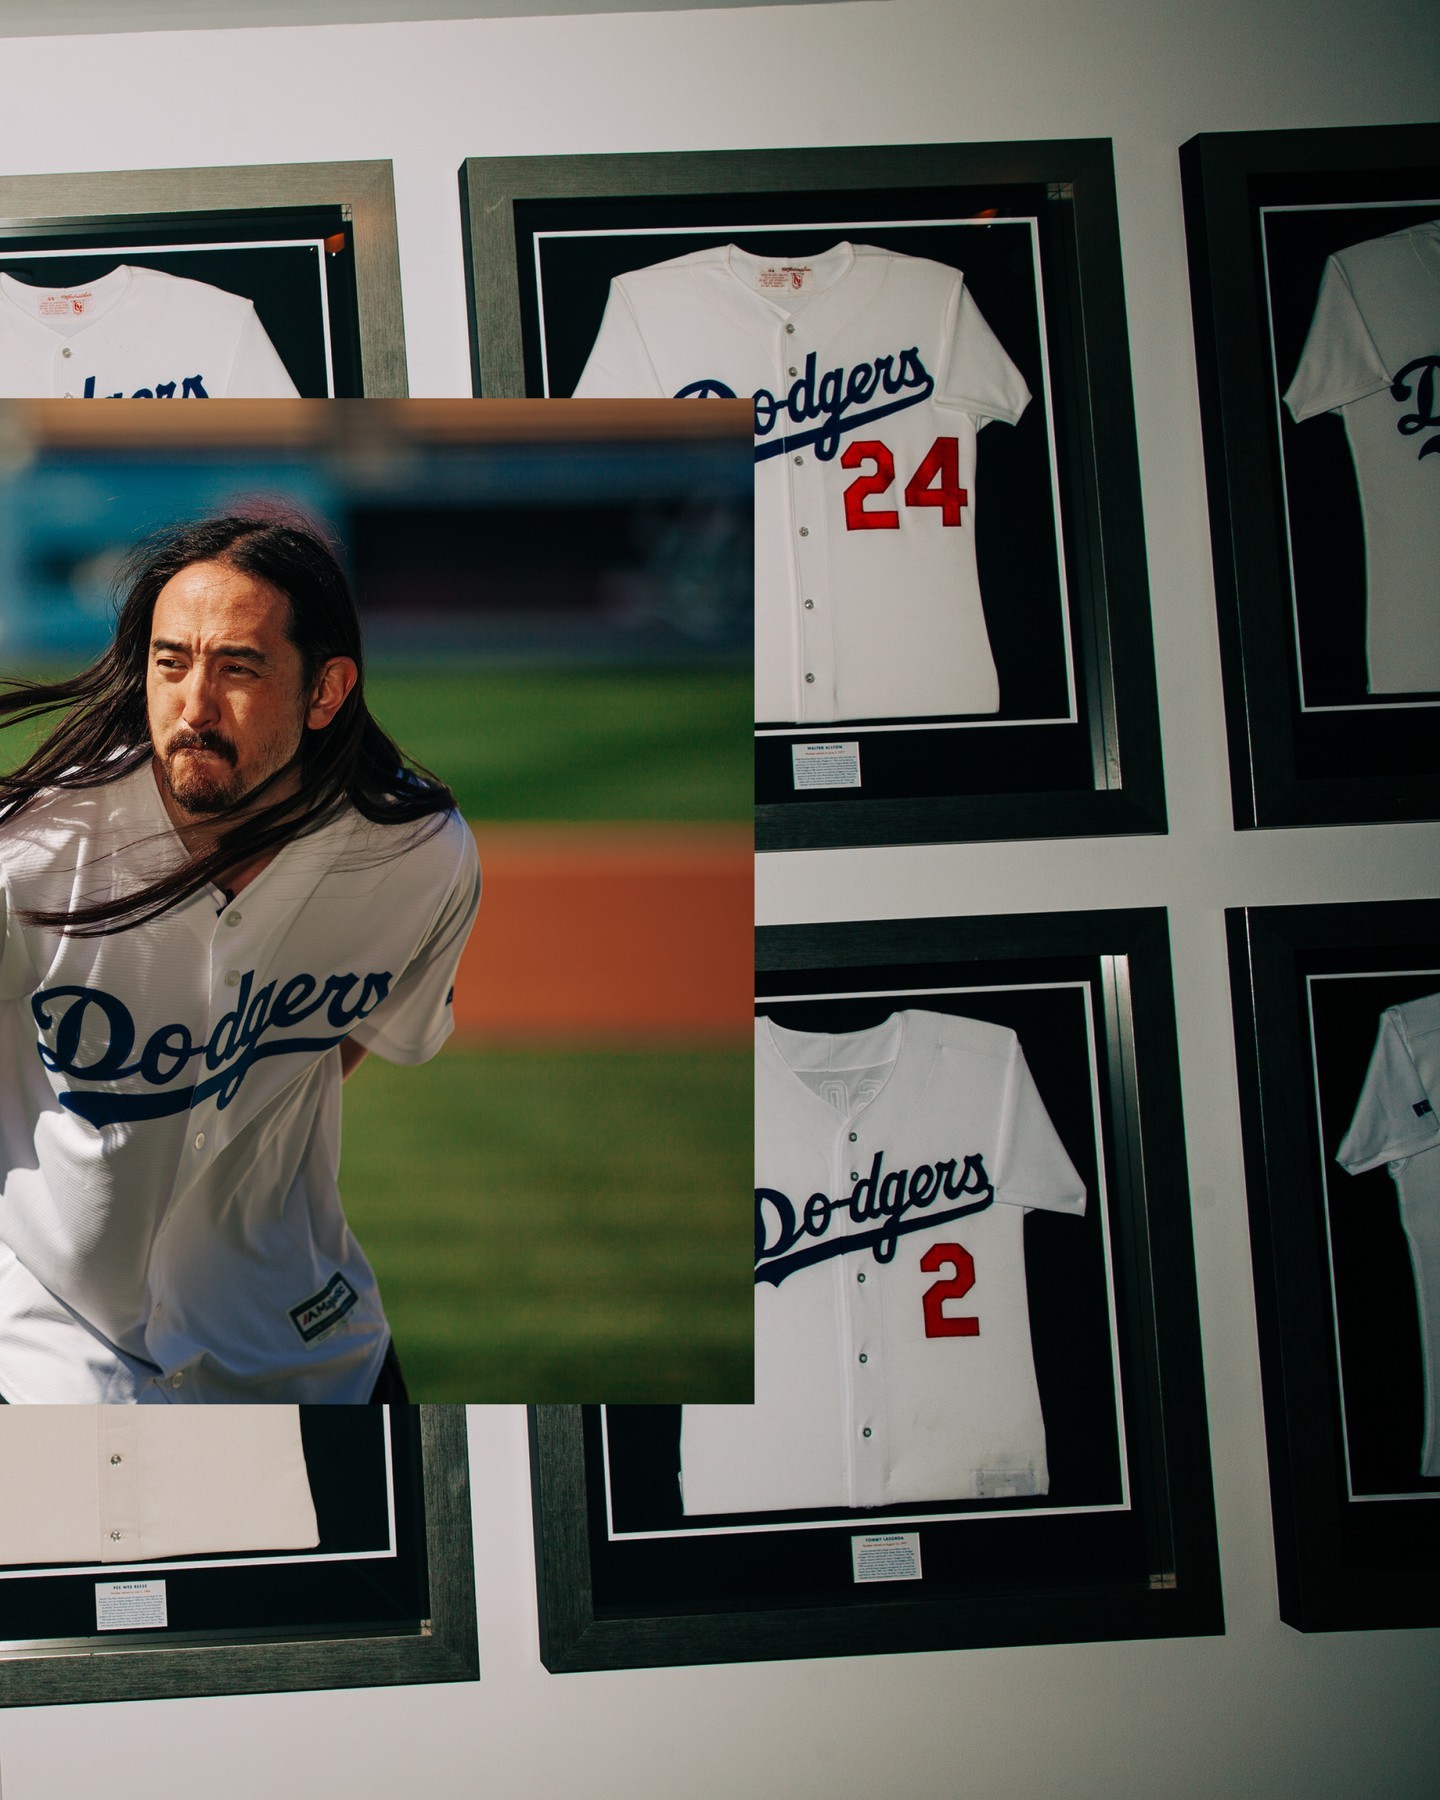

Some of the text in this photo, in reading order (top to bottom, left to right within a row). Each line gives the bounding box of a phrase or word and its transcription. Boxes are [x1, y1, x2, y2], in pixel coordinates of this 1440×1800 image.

[672, 347, 935, 461] odgers
[840, 436, 968, 531] 24
[31, 969, 393, 1111] Dodgers
[919, 1243, 980, 1338] 2
